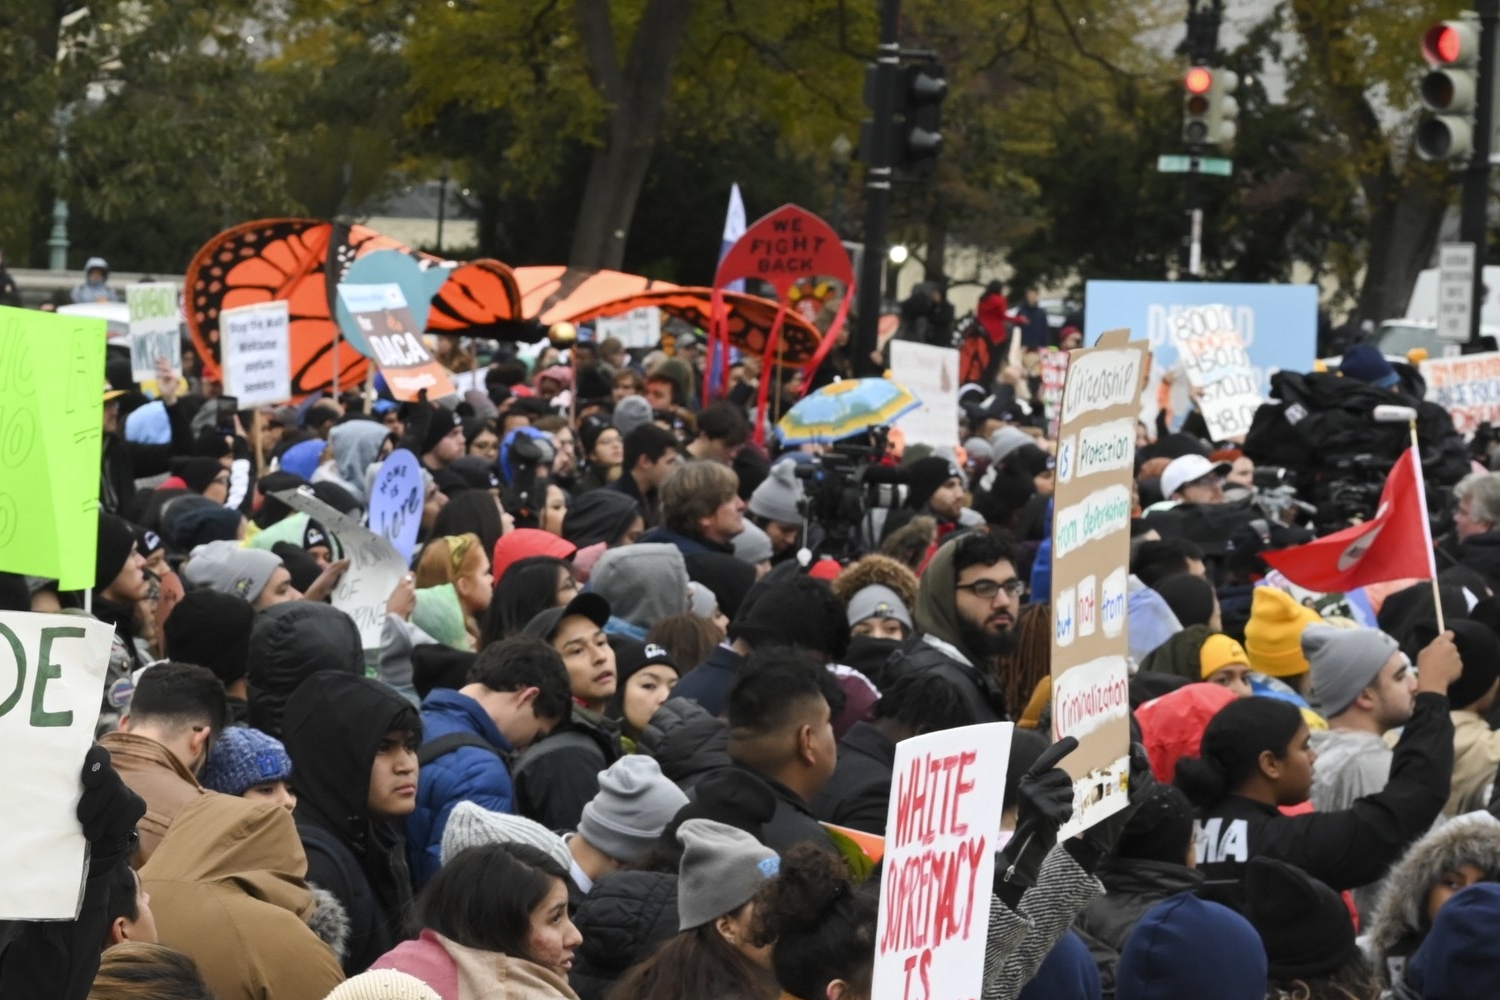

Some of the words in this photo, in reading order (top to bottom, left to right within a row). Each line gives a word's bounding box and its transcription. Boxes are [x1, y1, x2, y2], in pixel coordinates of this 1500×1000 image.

[772, 217, 803, 233] WE
[750, 236, 826, 256] FIGHT
[758, 257, 814, 274] BACK
[368, 332, 430, 366] DACA
[1080, 434, 1128, 467] Protection
[380, 465, 408, 494] HOME
[1056, 604, 1072, 638] but
[1078, 589, 1095, 625] not
[1101, 591, 1125, 622] from
[1055, 675, 1127, 740] Criminalization
[894, 748, 977, 848] WHITE
